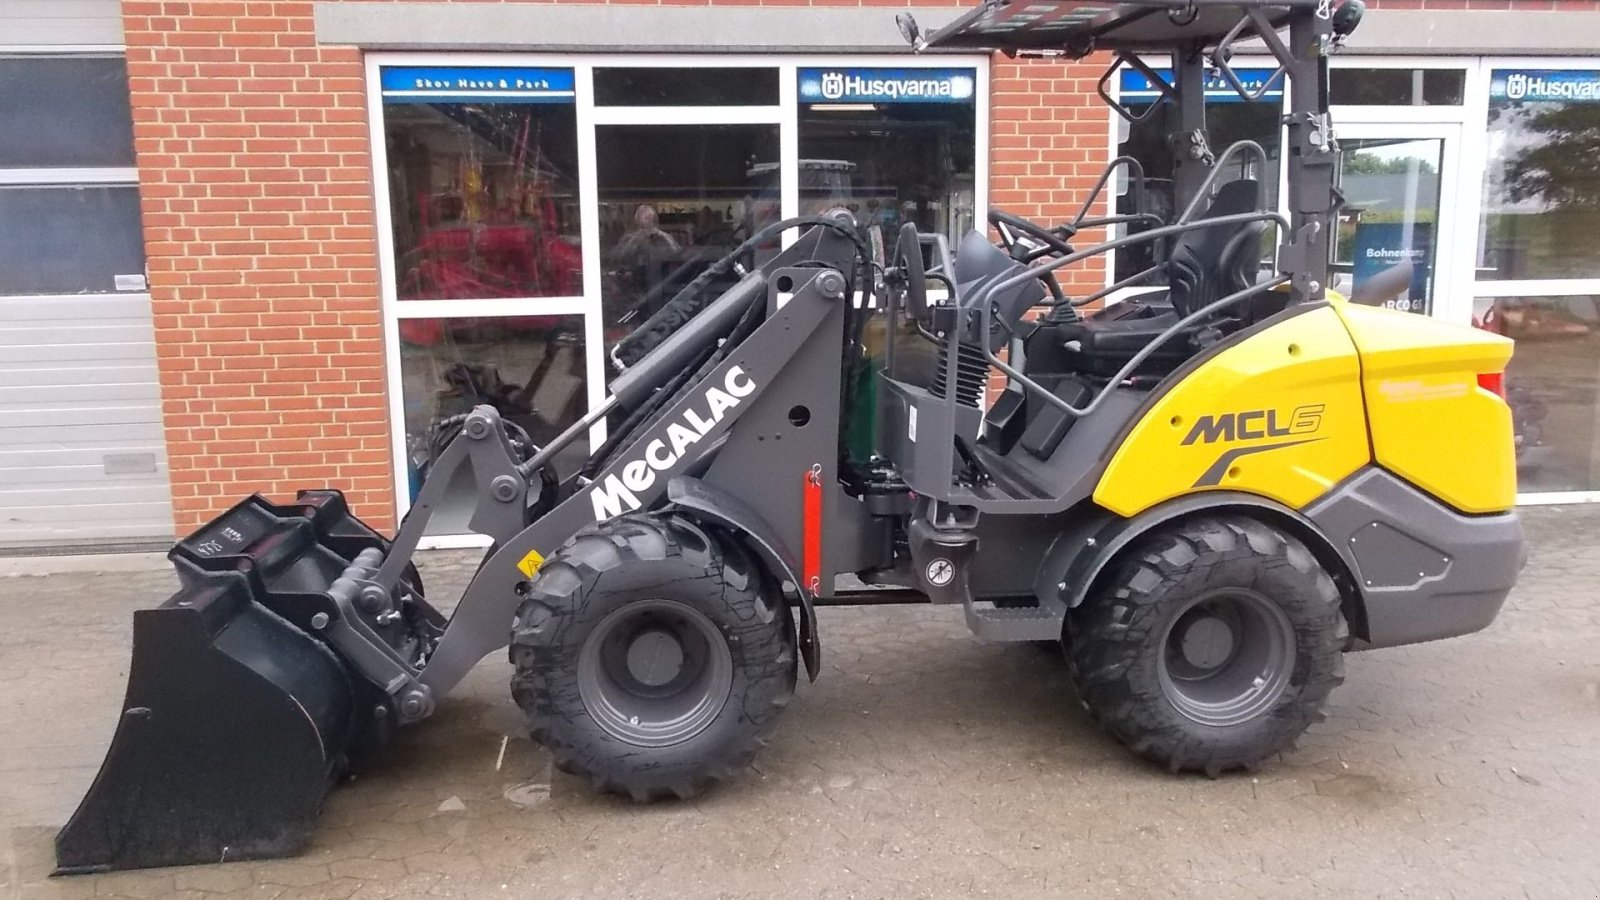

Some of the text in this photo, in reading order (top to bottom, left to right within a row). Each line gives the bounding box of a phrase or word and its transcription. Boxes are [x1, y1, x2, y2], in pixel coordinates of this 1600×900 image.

[415, 79, 450, 88] Skov
[458, 79, 494, 88] Have
[516, 79, 550, 89] Park
[845, 76, 950, 98] Husqvarna
[1241, 79, 1263, 89] ark
[1180, 404, 1326, 446] MCL6
